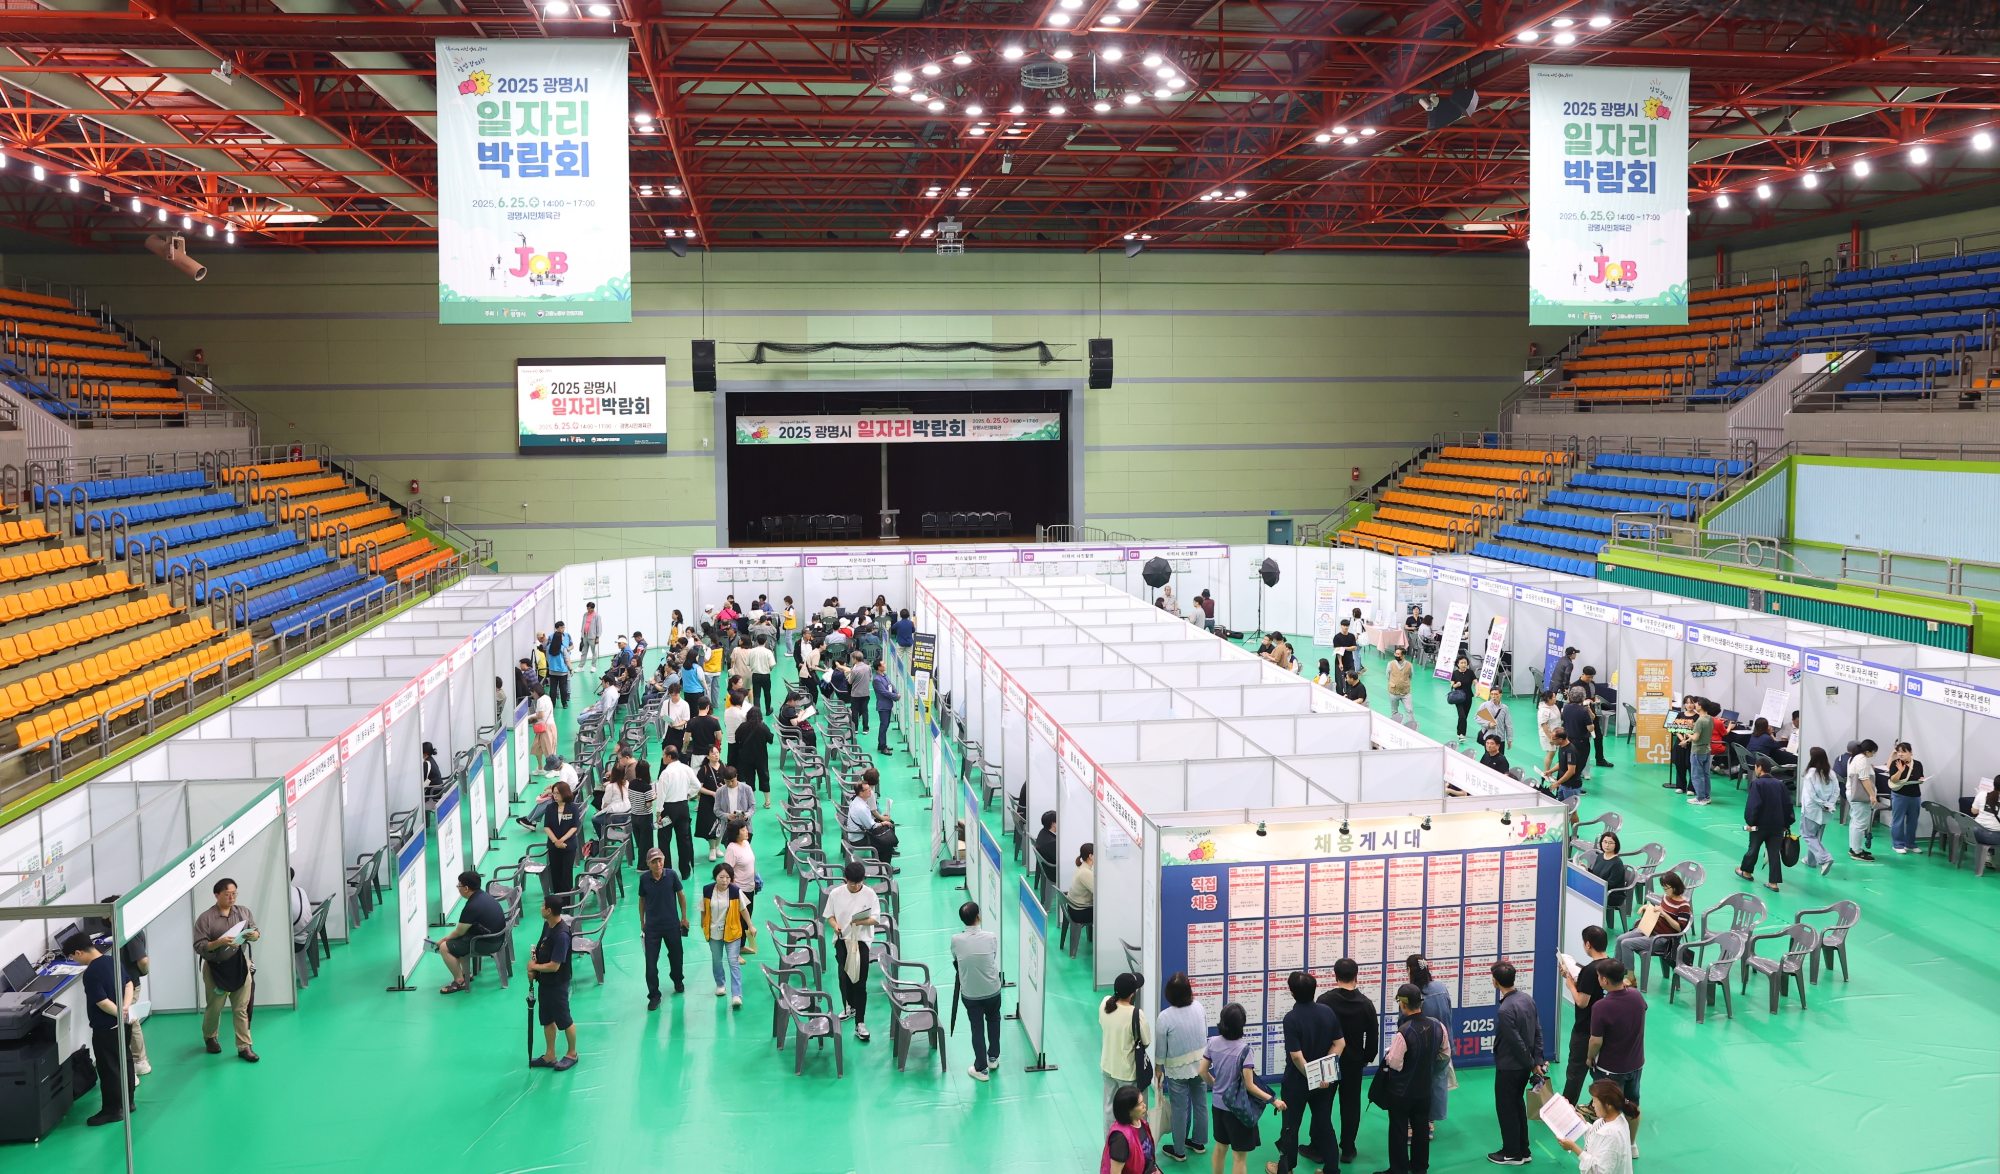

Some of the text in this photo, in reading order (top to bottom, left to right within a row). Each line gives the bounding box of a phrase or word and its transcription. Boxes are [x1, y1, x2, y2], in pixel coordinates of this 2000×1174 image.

[497, 77, 588, 93] 2025 광명시
[1563, 101, 1638, 117] 2025 광명시
[476, 100, 589, 137] 일자리
[1564, 122, 1657, 157] 일자리
[477, 140, 590, 178] 박람회
[1564, 159, 1656, 194] 박람회
[507, 211, 561, 221] 광명시민체육관
[1587, 224, 1632, 232] 광명시민체육관
[551, 381, 617, 395] 2025 광명시
[552, 397, 650, 416] 일자리박람회
[778, 419, 966, 439] 2025 광명시 일자리박람회
[1807, 659, 1819, 669] B02
[1908, 682, 1922, 692] B01
[1518, 821, 1547, 838] JOB
[1192, 876, 1217, 892] 직접
[1192, 895, 1217, 910] 채용
[1462, 1018, 1495, 1034] 2025
